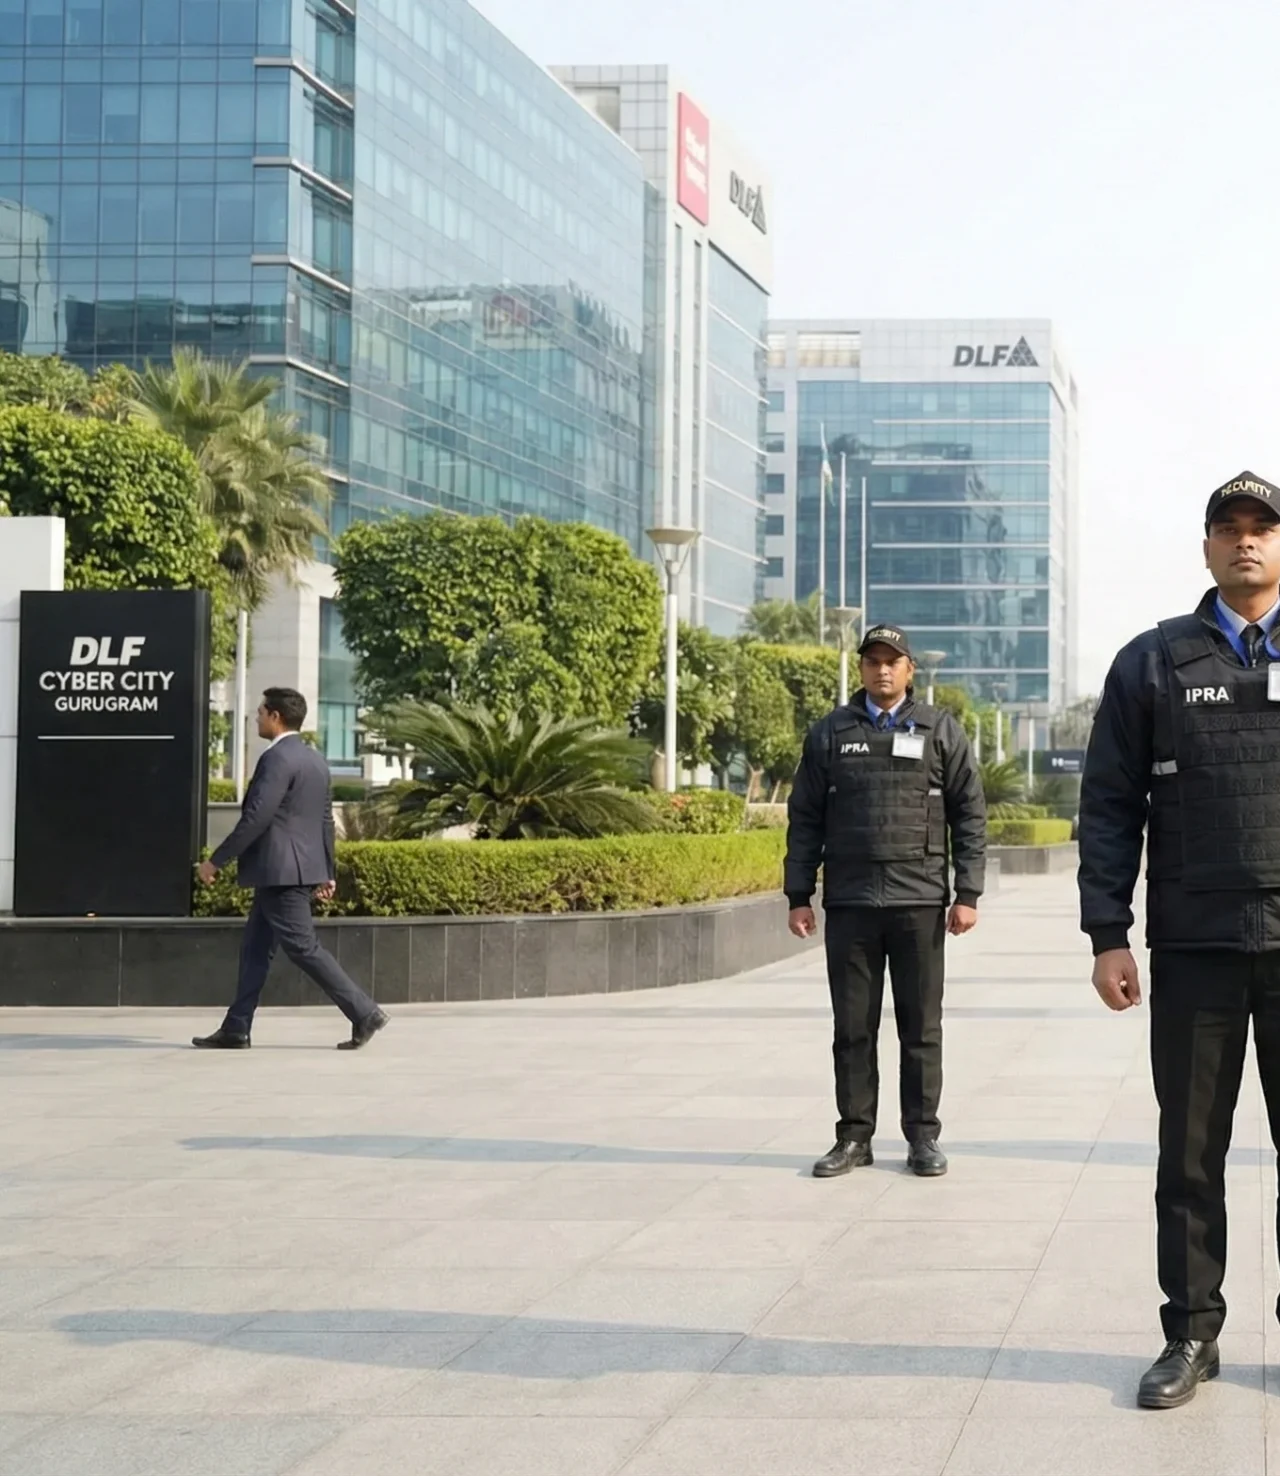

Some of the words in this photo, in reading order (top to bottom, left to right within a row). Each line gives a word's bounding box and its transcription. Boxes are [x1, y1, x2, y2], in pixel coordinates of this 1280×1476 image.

[953, 345, 1010, 367] DLF
[70, 636, 146, 666] DLF
[39, 671, 115, 690] CYBER
[120, 671, 174, 690] CITY
[55, 696, 158, 711] GURUGRAM
[1186, 686, 1229, 703] IPRA
[840, 743, 869, 754] IPRA
